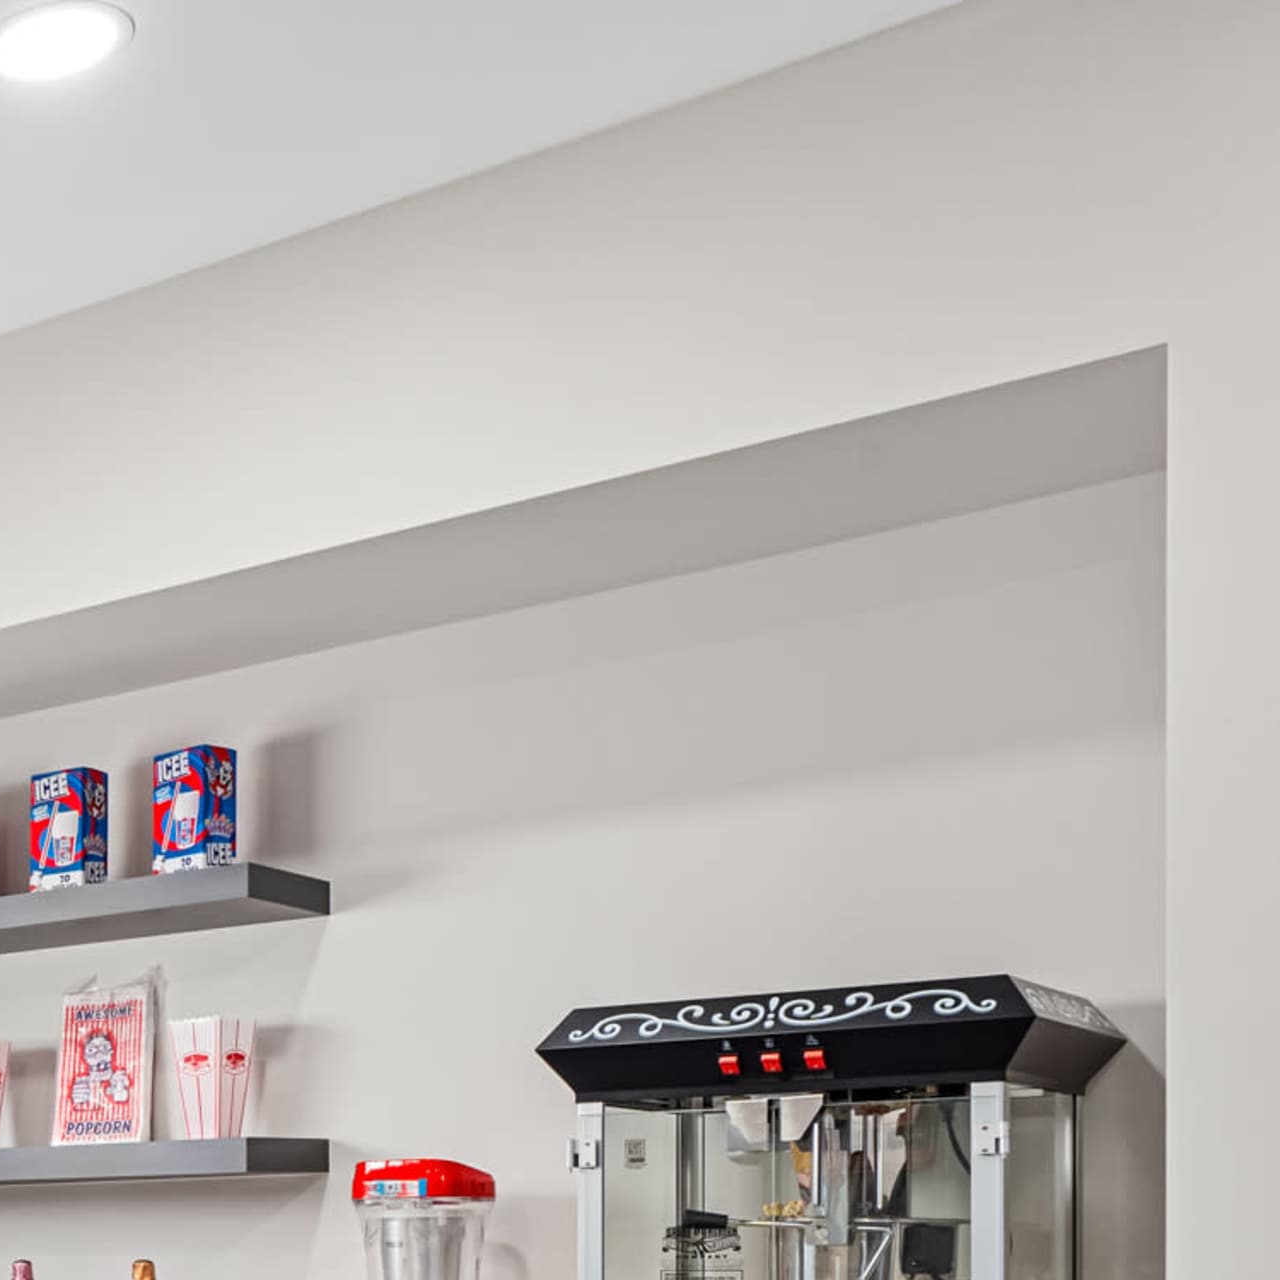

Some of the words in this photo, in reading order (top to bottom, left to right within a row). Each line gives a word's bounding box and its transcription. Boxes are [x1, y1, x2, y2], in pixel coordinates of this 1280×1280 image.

[157, 751, 191, 783] ICEE
[33, 773, 70, 803] ICEE
[76, 1006, 132, 1020] AWESOME
[67, 1120, 133, 1136] POPCORN
